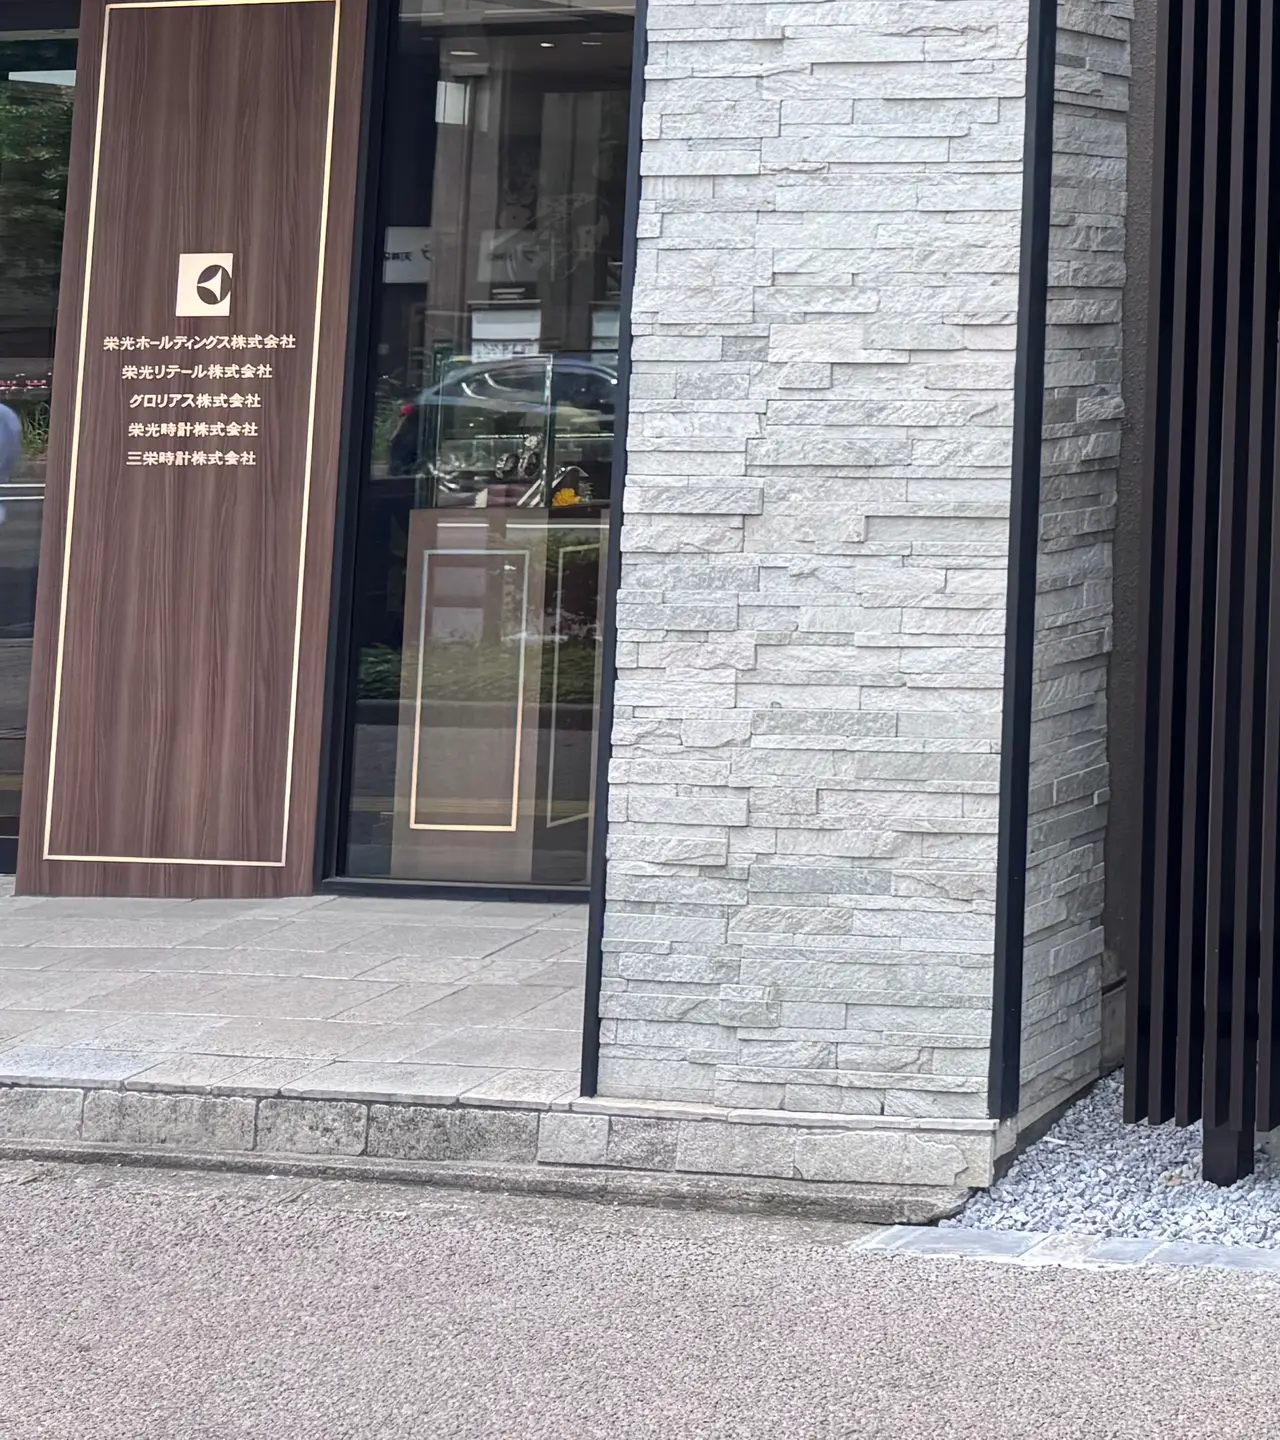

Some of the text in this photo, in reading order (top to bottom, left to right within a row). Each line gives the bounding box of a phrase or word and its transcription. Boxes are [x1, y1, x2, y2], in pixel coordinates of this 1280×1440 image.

[103, 334, 296, 351] 栄光ホールディングス株式会社
[122, 364, 272, 379] 栄光リテール株式会社
[129, 393, 261, 408] グロリアス株式会社
[128, 422, 258, 437] 栄光時計株式会社
[126, 451, 256, 466] 三栄時計株式会社
